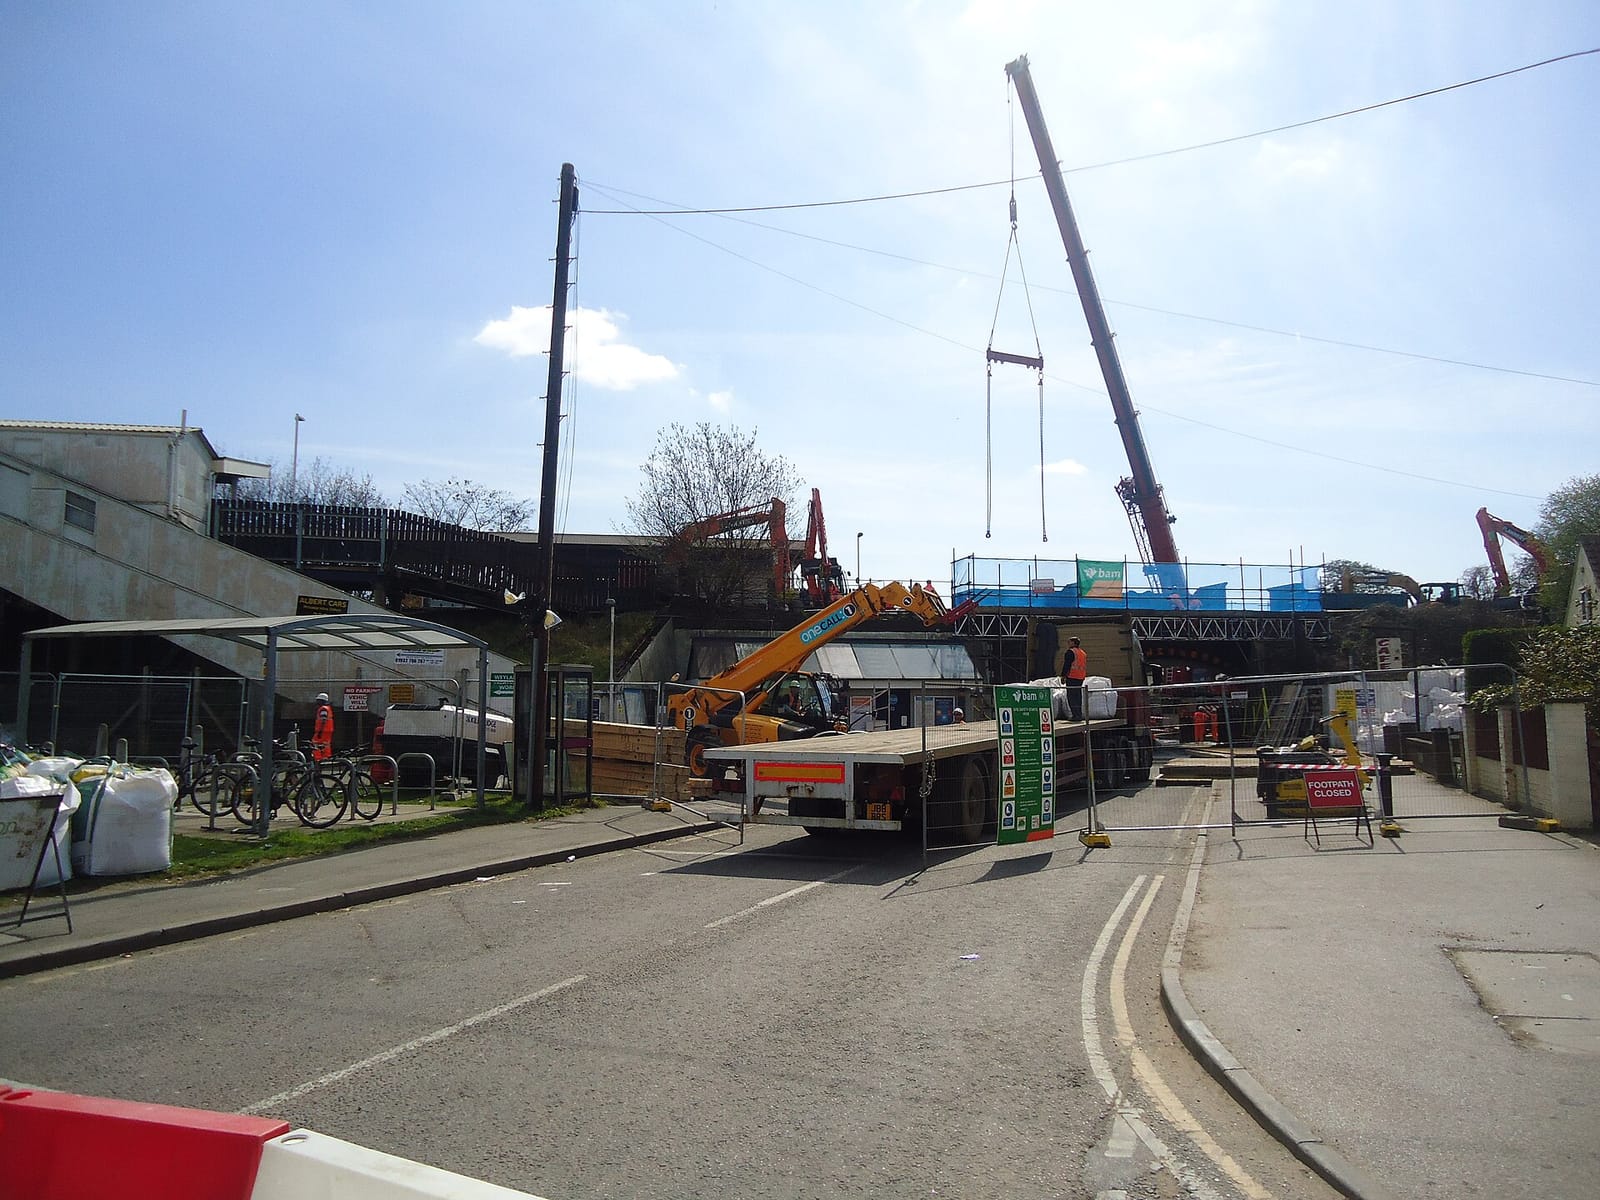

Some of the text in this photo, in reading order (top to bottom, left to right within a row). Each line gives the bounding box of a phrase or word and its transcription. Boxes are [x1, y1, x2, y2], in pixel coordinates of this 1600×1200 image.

[1098, 568, 1121, 578] bam
[299, 596, 347, 608] ALBERT CARS
[1378, 639, 1391, 670] CAFE
[1021, 690, 1037, 701] bam
[1308, 780, 1354, 789] FOOTPATH
[1314, 789, 1352, 797] CLOSED
